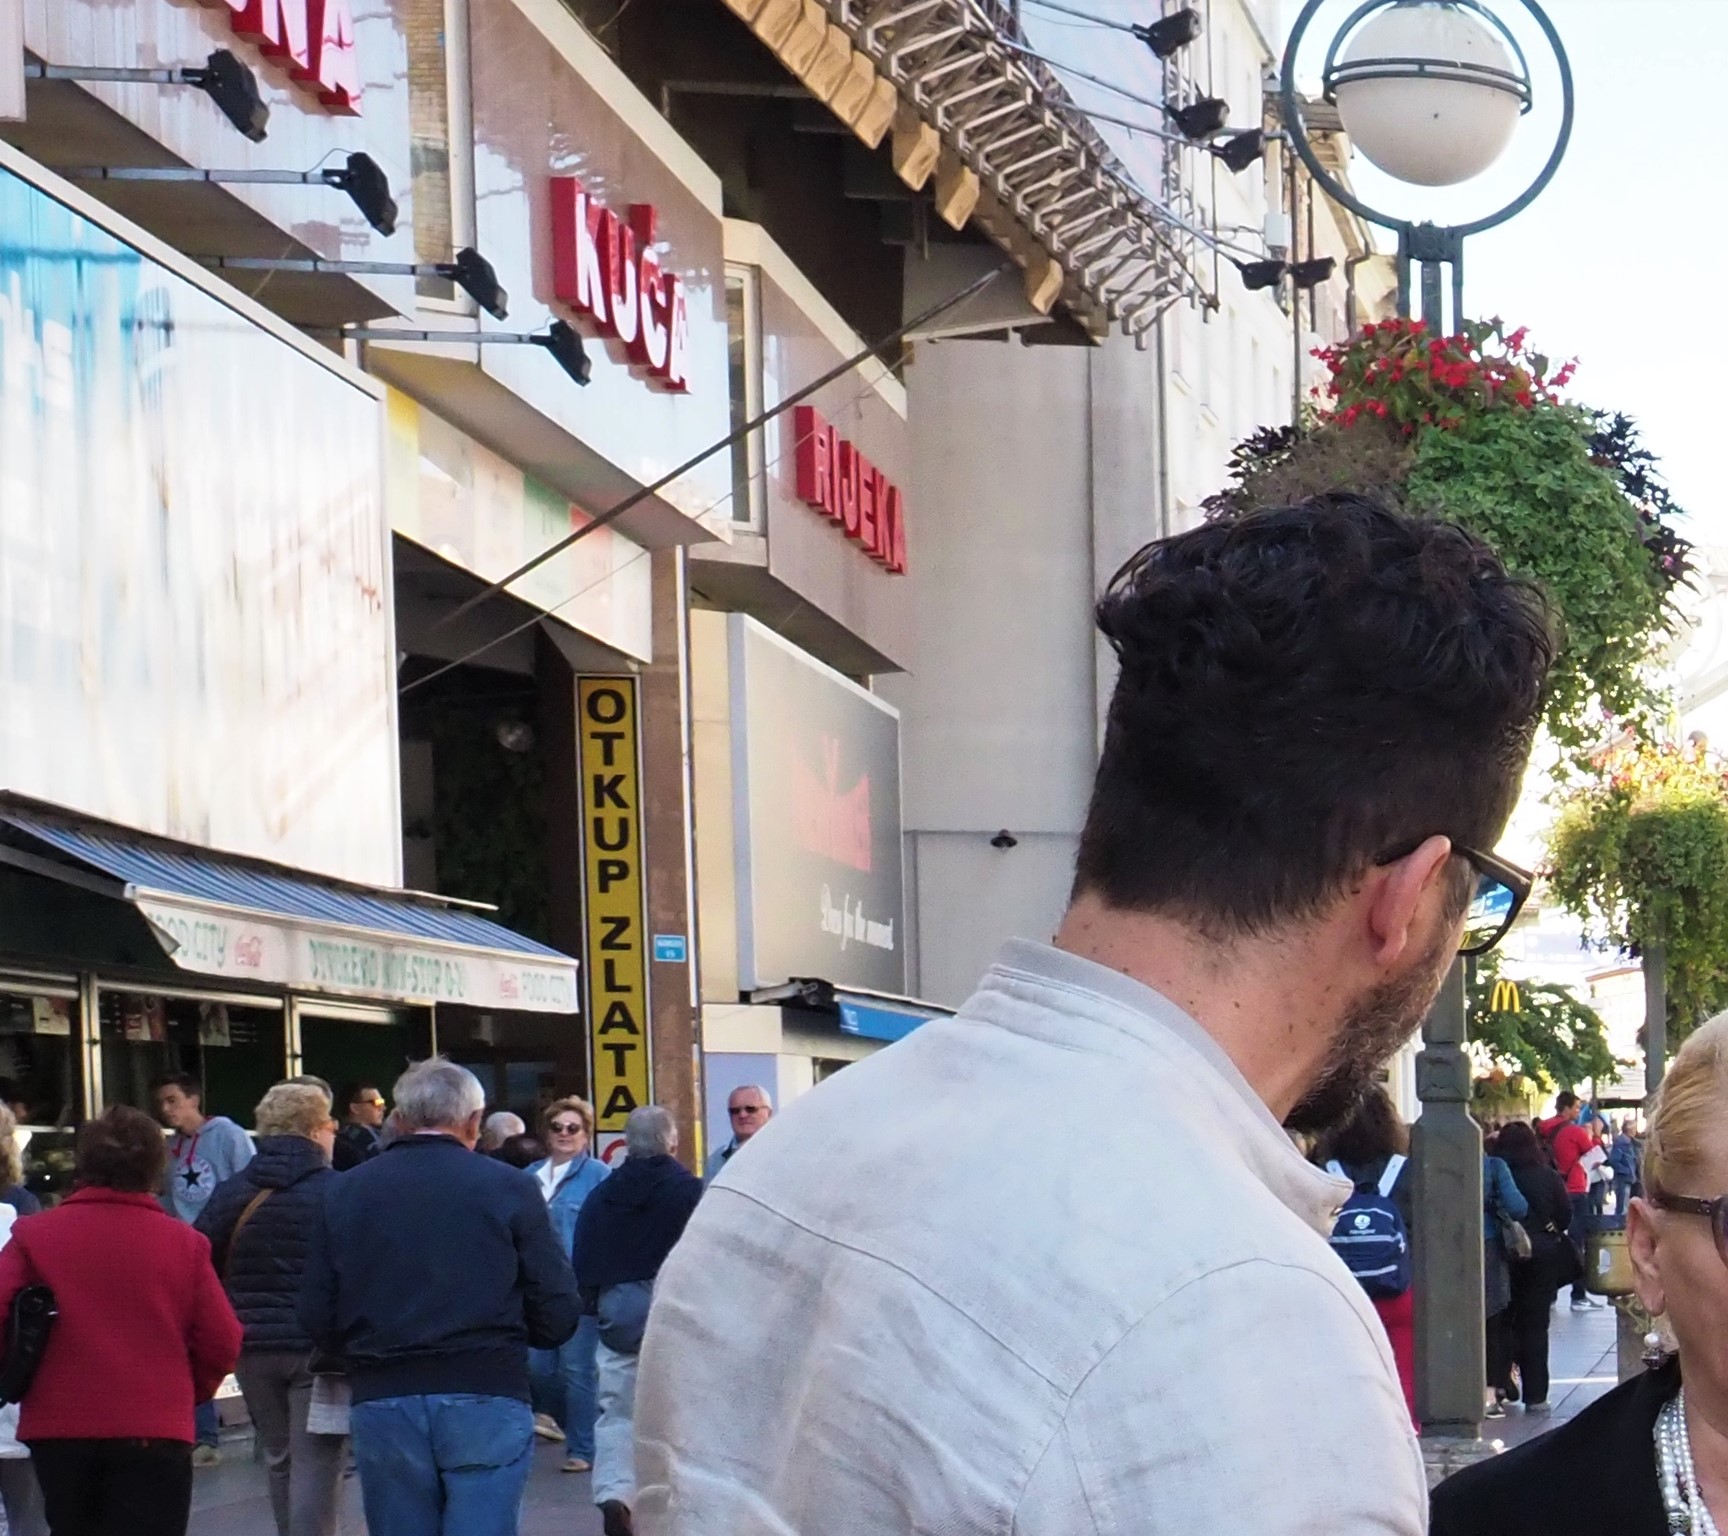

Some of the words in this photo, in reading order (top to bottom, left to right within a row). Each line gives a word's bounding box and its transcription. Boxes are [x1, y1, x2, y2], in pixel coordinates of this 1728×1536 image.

[795, 406, 908, 577] RIJEKA
[587, 688, 631, 894] OTKUP
[599, 915, 640, 1120] ZLATA
